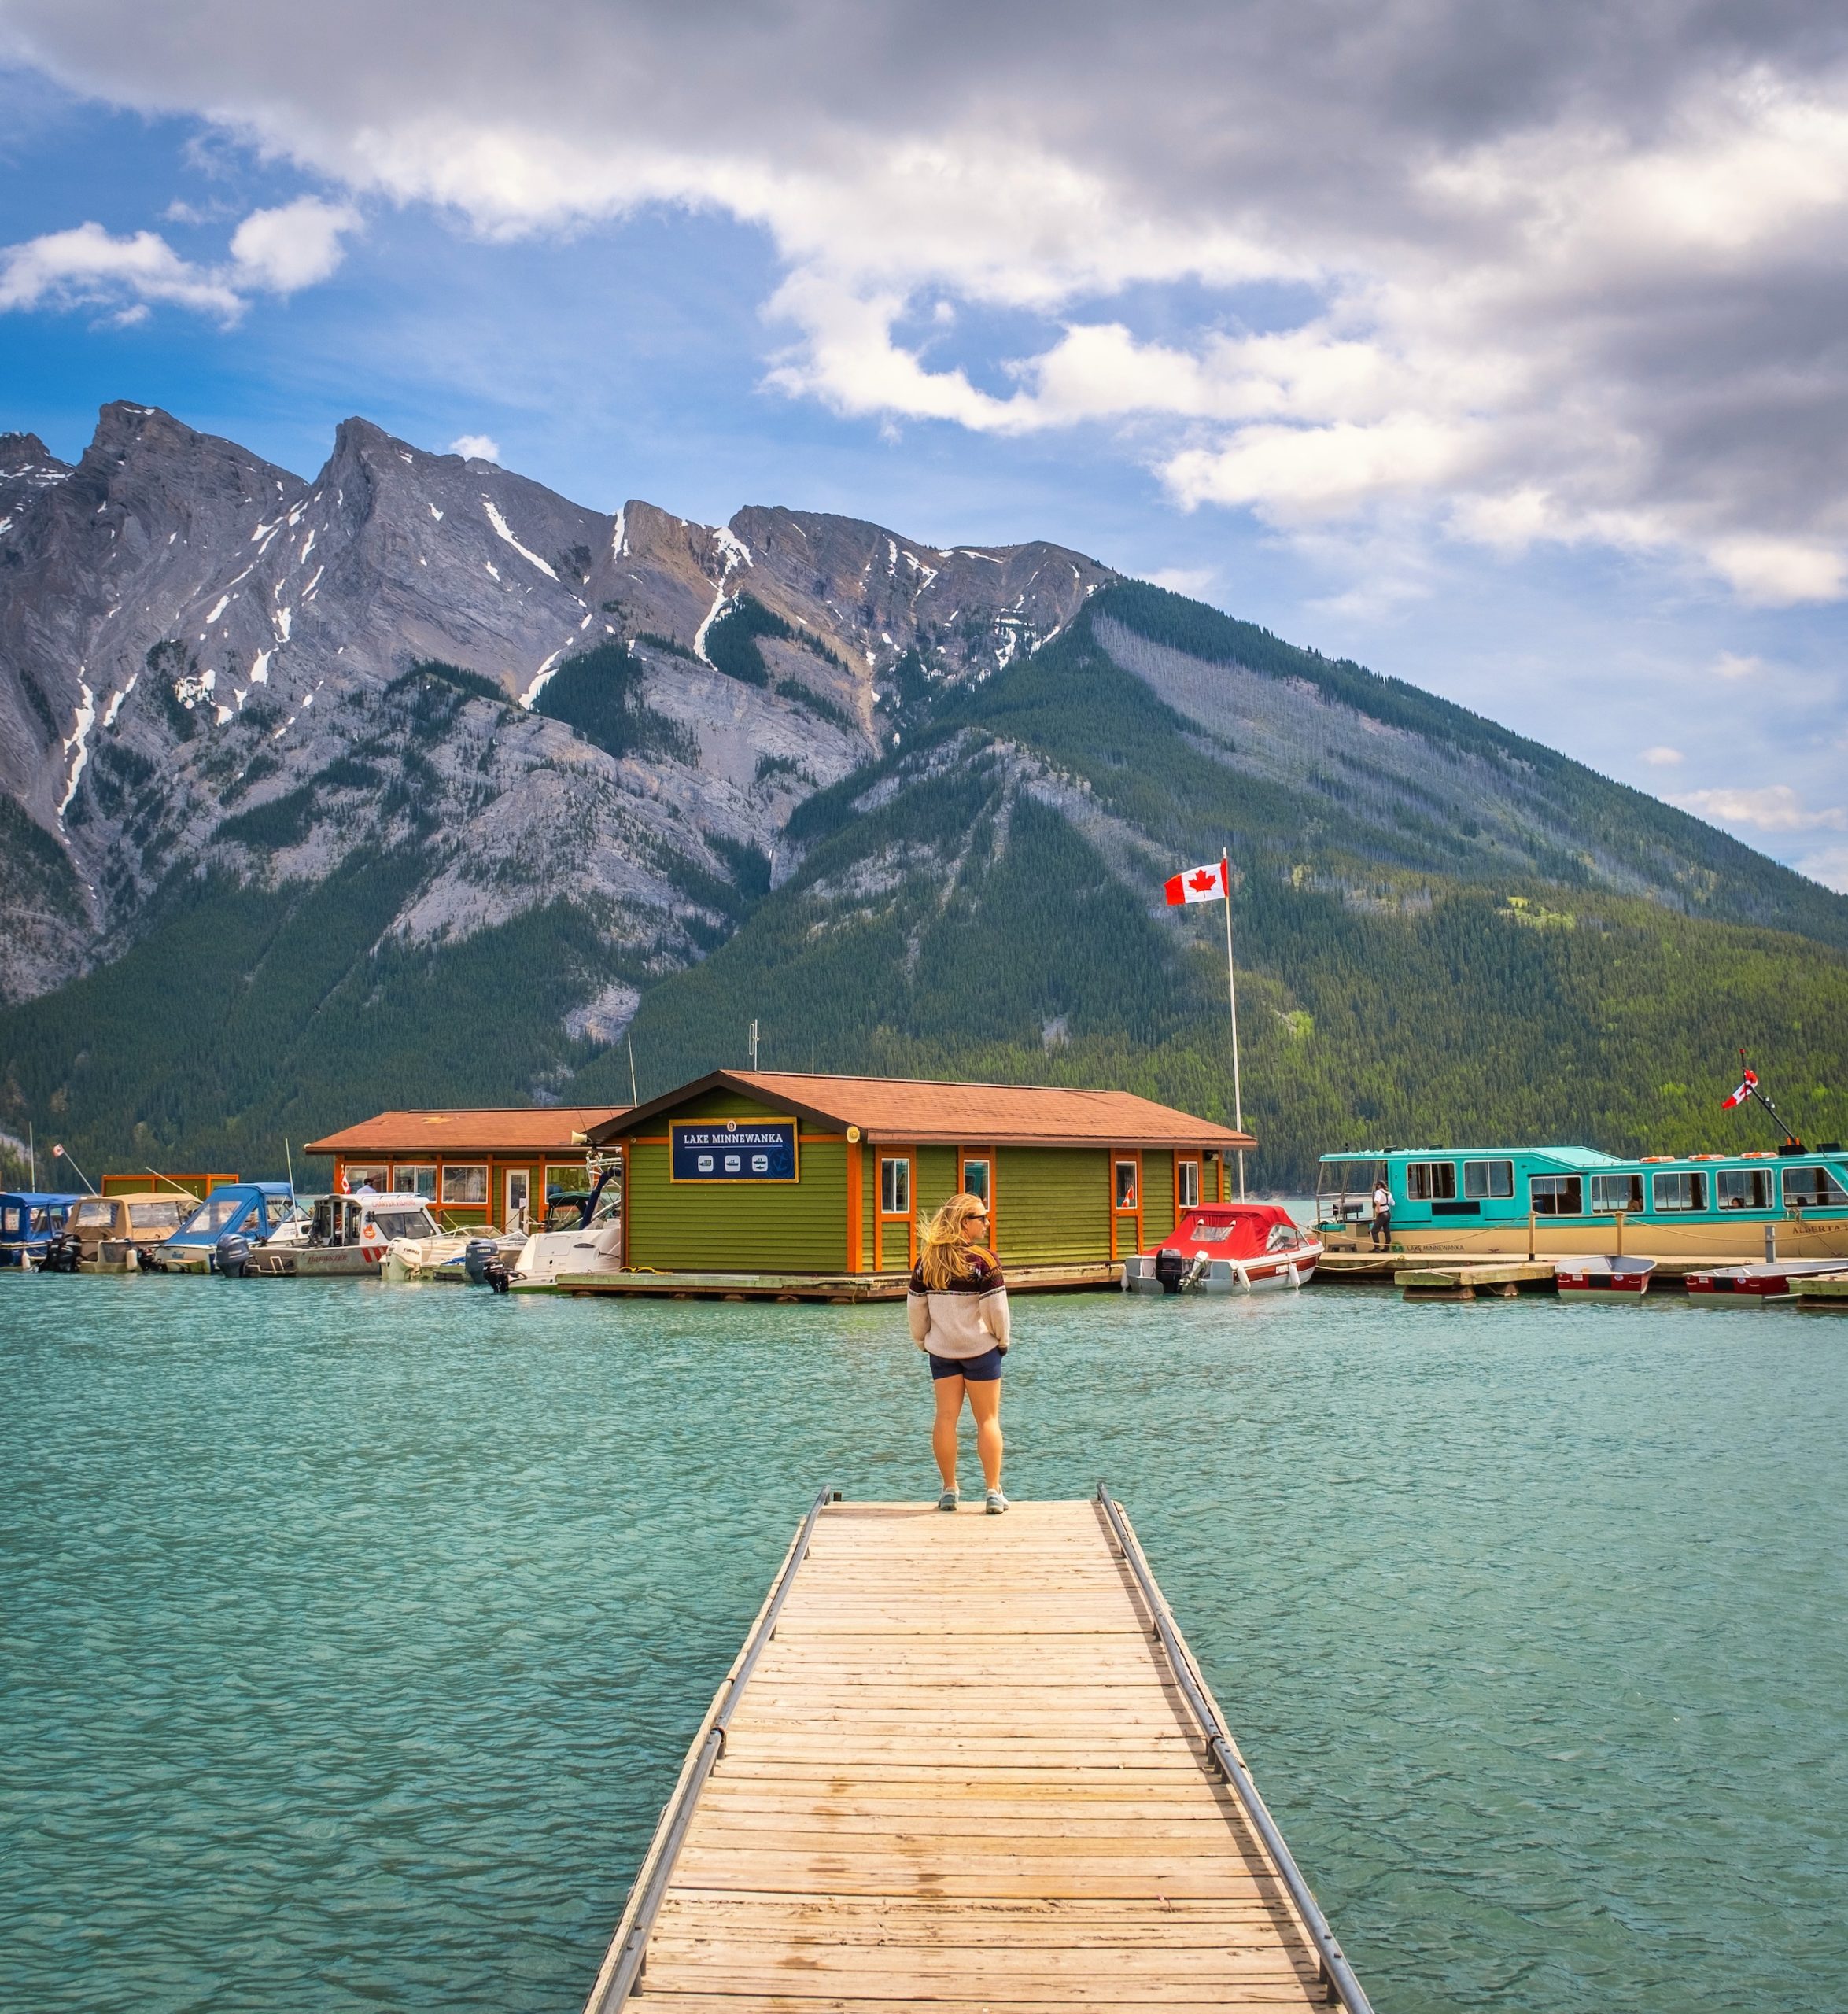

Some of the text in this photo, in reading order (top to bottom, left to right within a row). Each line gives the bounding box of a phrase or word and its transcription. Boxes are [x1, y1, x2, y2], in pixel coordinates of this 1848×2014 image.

[684, 1134, 783, 1144] LAKE MINNEWANKA
[1793, 1225, 1840, 1234] ALBERTA
